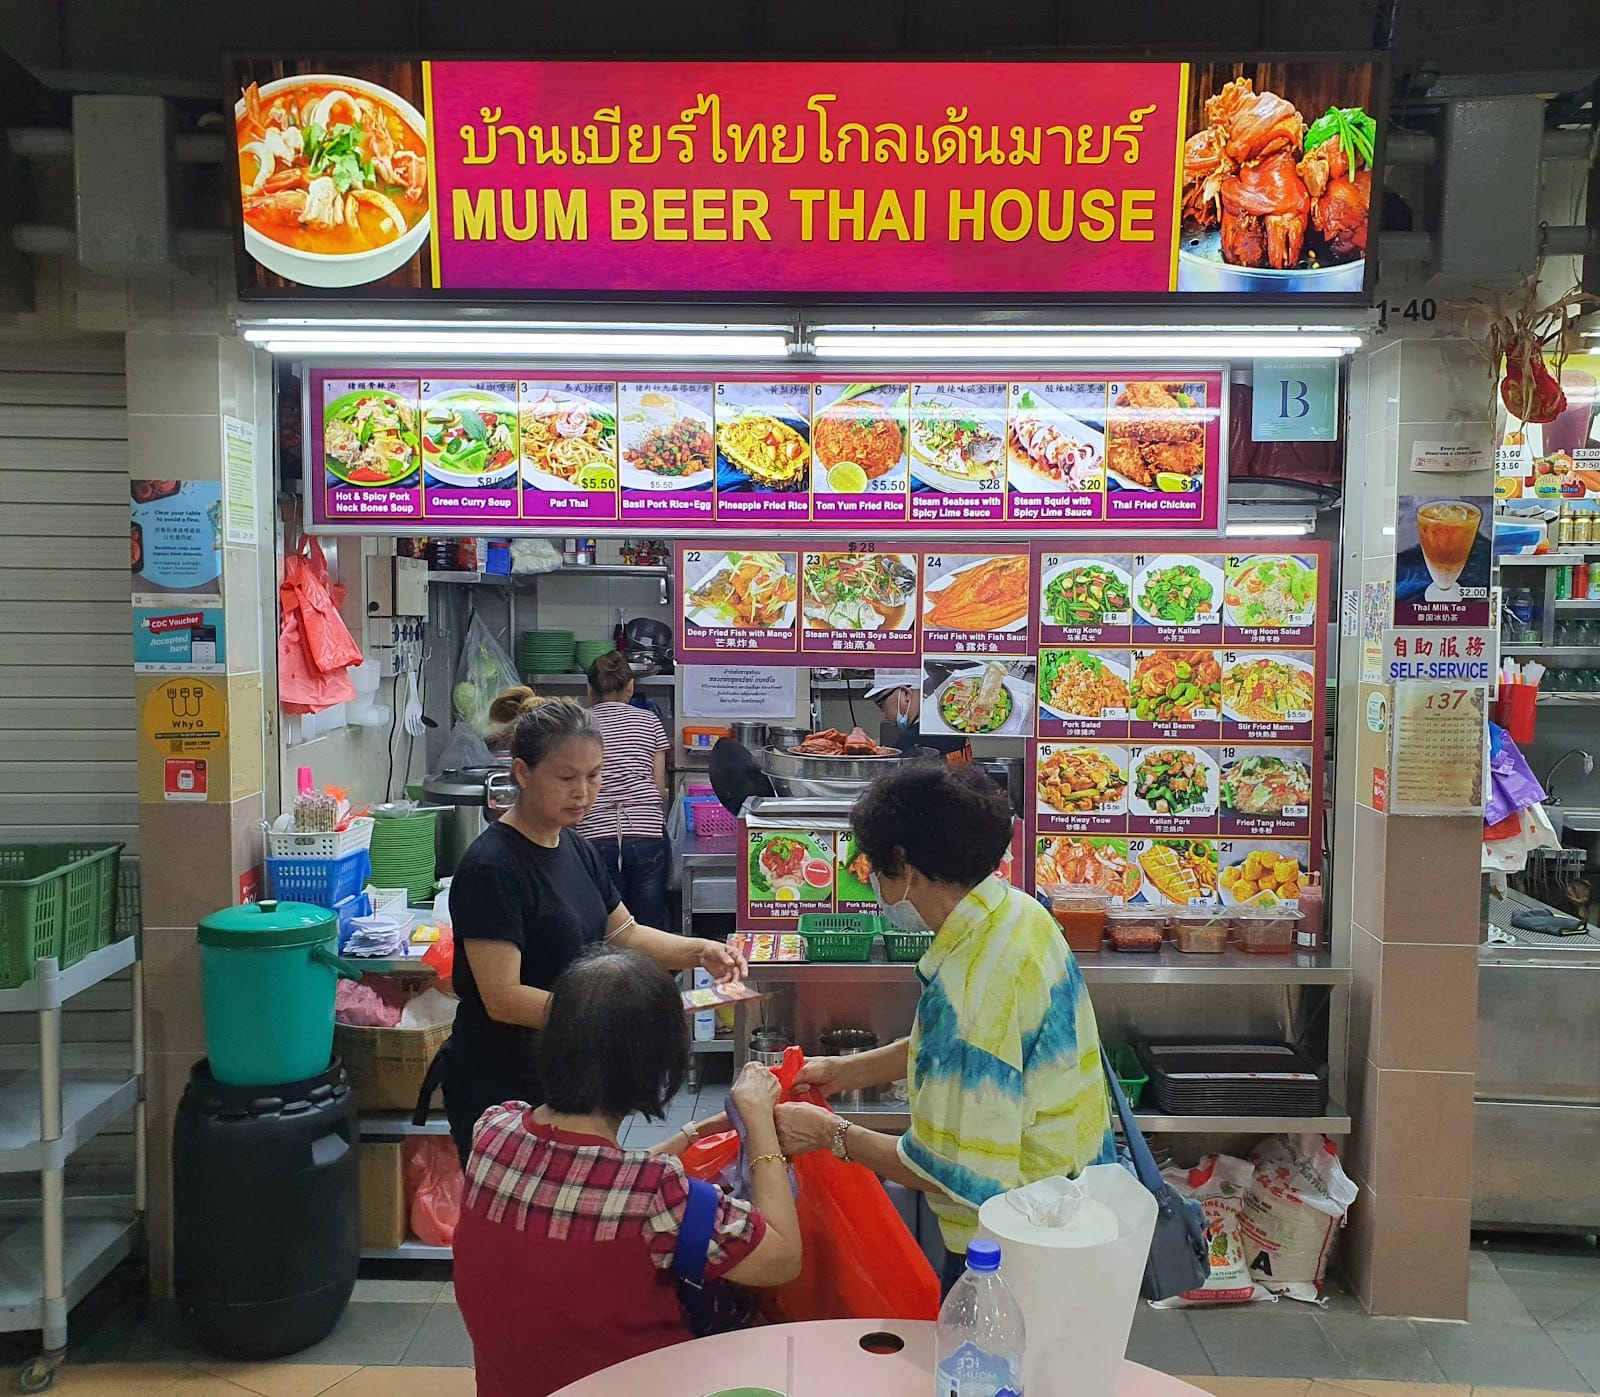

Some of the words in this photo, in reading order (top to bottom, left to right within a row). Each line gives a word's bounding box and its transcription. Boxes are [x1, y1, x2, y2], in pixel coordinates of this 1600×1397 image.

[453, 189, 588, 242] MUM
[612, 189, 773, 242] BEER
[790, 189, 925, 242] THAI
[949, 189, 1155, 243] HOUSE
[327, 383, 332, 391] 1
[423, 381, 430, 392] 2
[521, 382, 528, 393] 3
[621, 384, 627, 392] 4
[717, 385, 725, 395] 5
[815, 385, 822, 395] 6
[914, 385, 921, 395] 7
[1012, 385, 1019, 395] 8
[1111, 384, 1118, 394] 9
[1279, 380, 1310, 418] B
[581, 478, 615, 489] $5.50
[650, 481, 673, 489] $5.50
[871, 480, 906, 491] $5.50
[979, 479, 1000, 490] $28
[1079, 479, 1101, 490] $20
[336, 492, 353, 501] Hot
[354, 493, 361, 501] &
[362, 492, 388, 503] Spicy
[389, 492, 411, 501] Pork
[912, 497, 940, 506] Steam
[942, 497, 979, 506] Seabass
[980, 497, 1001, 506] with
[1013, 497, 1041, 506] Steam
[1043, 497, 1071, 508] Squid
[1072, 497, 1091, 506] with
[432, 497, 459, 507] Green
[460, 497, 486, 509] Curry
[488, 497, 512, 509] Soup
[549, 498, 568, 508] Pad
[569, 498, 588, 508] Thai
[623, 500, 645, 509] Basil
[647, 500, 668, 509] Pork
[718, 501, 761, 512] Pineapple
[763, 501, 786, 510] Fried
[788, 501, 808, 510] Rice
[816, 502, 836, 510] Tom
[838, 502, 858, 510] Yum
[859, 502, 882, 510] Fried
[884, 502, 904, 511] Rice
[1112, 500, 1132, 510] Thai
[1134, 500, 1158, 510] Fried
[1159, 500, 1197, 510] Chicken
[336, 503, 359, 512] Neck
[360, 503, 389, 512] Bones
[391, 503, 414, 514] Soup
[912, 508, 937, 519] Spicy
[939, 508, 961, 517] Lime
[962, 508, 991, 517] Sauce
[1013, 508, 1039, 518] Spicy
[1040, 508, 1063, 517] Lime
[1064, 508, 1092, 517] Sauce
[687, 552, 701, 562] 22
[807, 555, 820, 565] 23
[1047, 557, 1058, 566] 10
[1135, 555, 1145, 566] 11
[927, 557, 942, 568] 24
[1228, 557, 1240, 568] 12
[1459, 588, 1487, 598] $2.00
[1413, 603, 1431, 612] Thai
[1432, 603, 1450, 612] Milk
[1451, 604, 1466, 612] Tea
[151, 620, 167, 628] CDC
[169, 616, 199, 626] Voucher
[687, 628, 706, 638] Deep
[708, 629, 729, 637] Fried
[730, 629, 747, 638] Fish
[748, 629, 766, 638] with
[766, 630, 793, 639] Mango
[805, 631, 830, 639] Steam
[831, 631, 848, 639] Fish
[867, 632, 887, 641] Soya
[889, 632, 912, 640] Sauce
[928, 632, 949, 640] Fried
[950, 632, 968, 641] Fish
[969, 633, 986, 641] with
[987, 633, 1005, 641] Fish
[1062, 627, 1082, 636] Kang
[1083, 627, 1102, 636] Kong
[1157, 627, 1177, 637] Baby
[1240, 628, 1258, 636] Tang
[151, 635, 188, 646] Accepted
[169, 645, 188, 653] here
[1133, 651, 1144, 660] 14
[1224, 652, 1236, 662] 15
[1390, 662, 1488, 679] SELF-SERVICE
[172, 720, 193, 729] Why
[1063, 721, 1080, 729] Pork
[1081, 721, 1101, 729] Salad
[1040, 746, 1052, 756] 16
[1130, 747, 1142, 757] 17
[1222, 747, 1235, 758] 18
[1071, 816, 1090, 824] Kway
[750, 832, 763, 842] 25
[1039, 839, 1052, 849] 19
[1130, 841, 1144, 851] 20
[1221, 842, 1233, 852] 21
[763, 902, 774, 911] Leg
[787, 902, 798, 910] (Pig
[817, 902, 831, 910] Rice)
[862, 902, 878, 910] Satay
